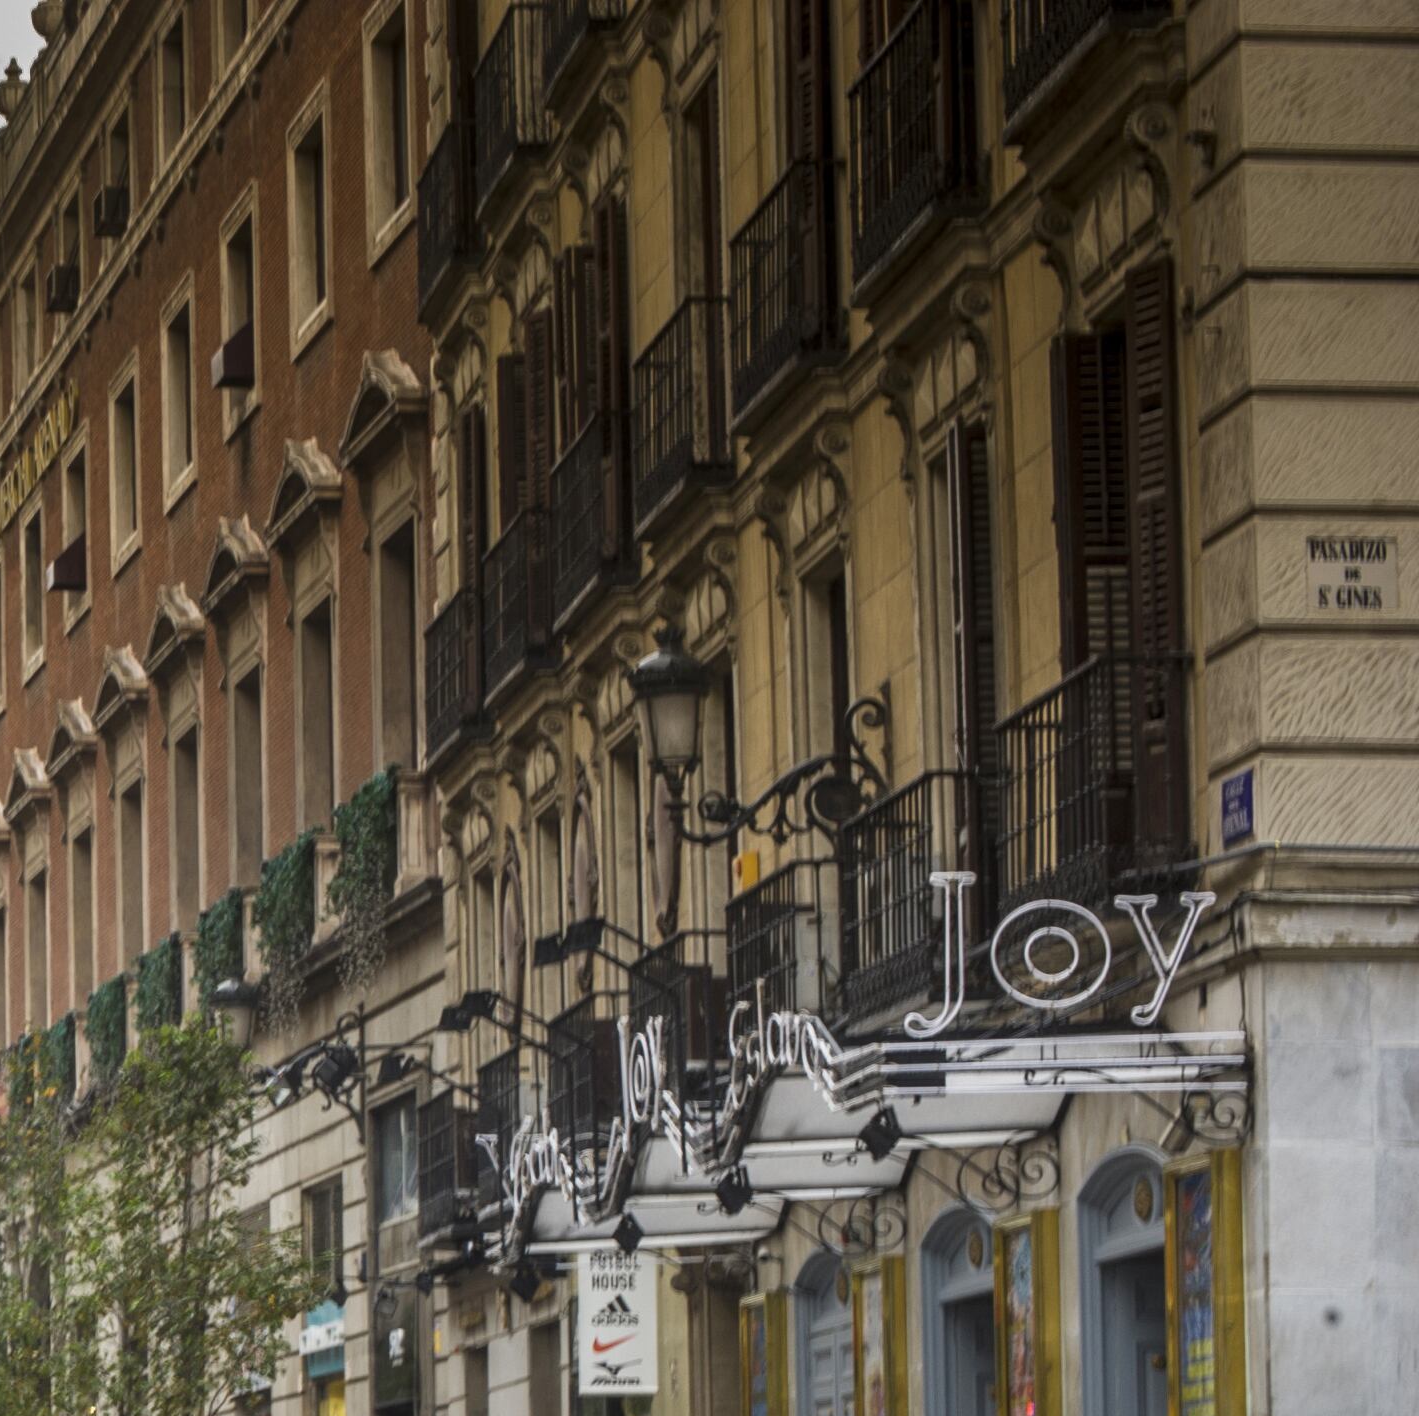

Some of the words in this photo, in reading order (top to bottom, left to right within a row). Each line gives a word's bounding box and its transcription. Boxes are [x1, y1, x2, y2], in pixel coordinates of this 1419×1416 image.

[1310, 538, 1387, 562] PASADIZO
[1345, 566, 1361, 582] DE
[591, 1272, 637, 1291] HOUSE
